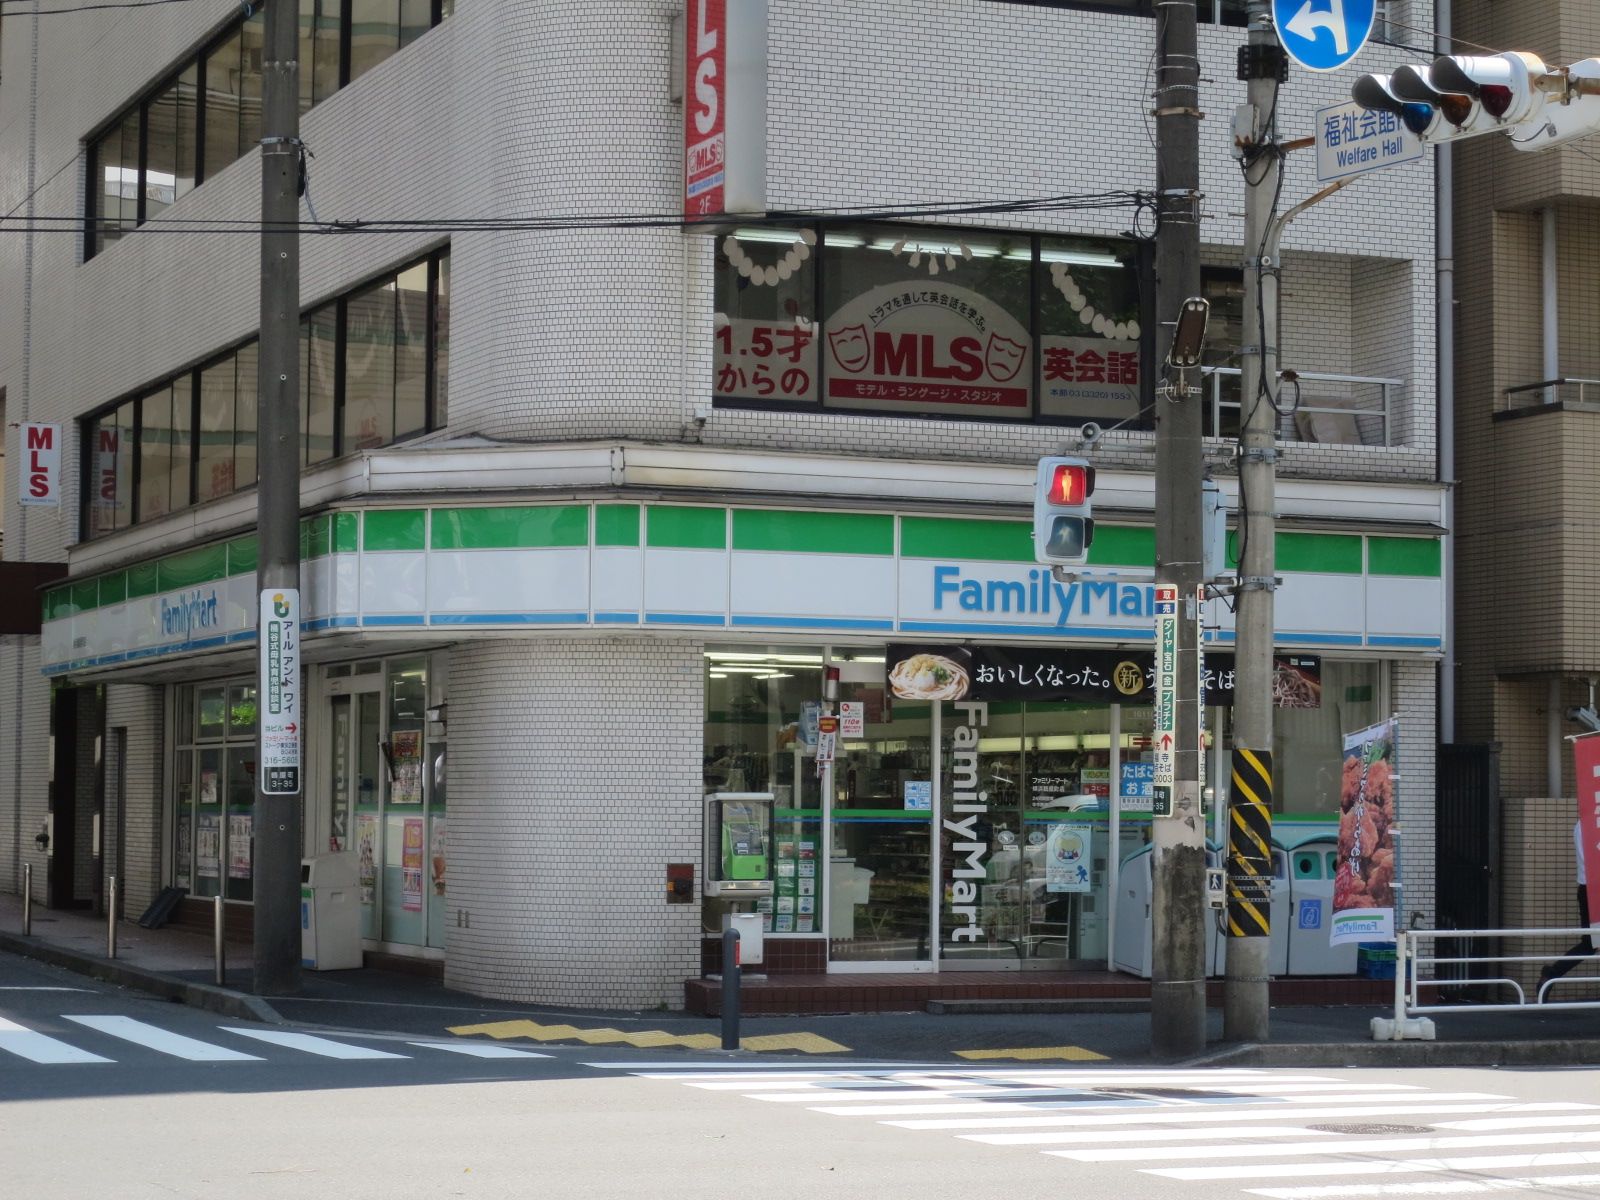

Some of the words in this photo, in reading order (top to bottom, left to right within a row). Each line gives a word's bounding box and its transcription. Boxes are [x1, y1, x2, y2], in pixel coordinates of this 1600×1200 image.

[1324, 109, 1403, 148] 福祉会館
[696, 143, 716, 172] MLS
[1336, 145, 1377, 168] Welfare
[1382, 136, 1403, 157] Hall
[716, 325, 813, 362] 1.5才
[873, 331, 985, 382] MLS
[717, 362, 810, 396] からの
[1043, 348, 1138, 385] 英会話
[855, 383, 1003, 402] モデル・ランゲージ・スタジオ
[27, 427, 53, 497] MLS
[161, 589, 217, 641] FamilyMart
[1163, 619, 1173, 648] ダイヤ
[976, 664, 1110, 689] おいしくなった。
[1119, 667, 1139, 688] 新
[1163, 653, 1173, 671] 宝石
[1162, 675, 1172, 686] 金
[1162, 691, 1172, 729] プラチナ
[271, 780, 293, 788] 3-35
[1032, 777, 1069, 785] ファミリーマート
[943, 702, 988, 942] FamilyMart
